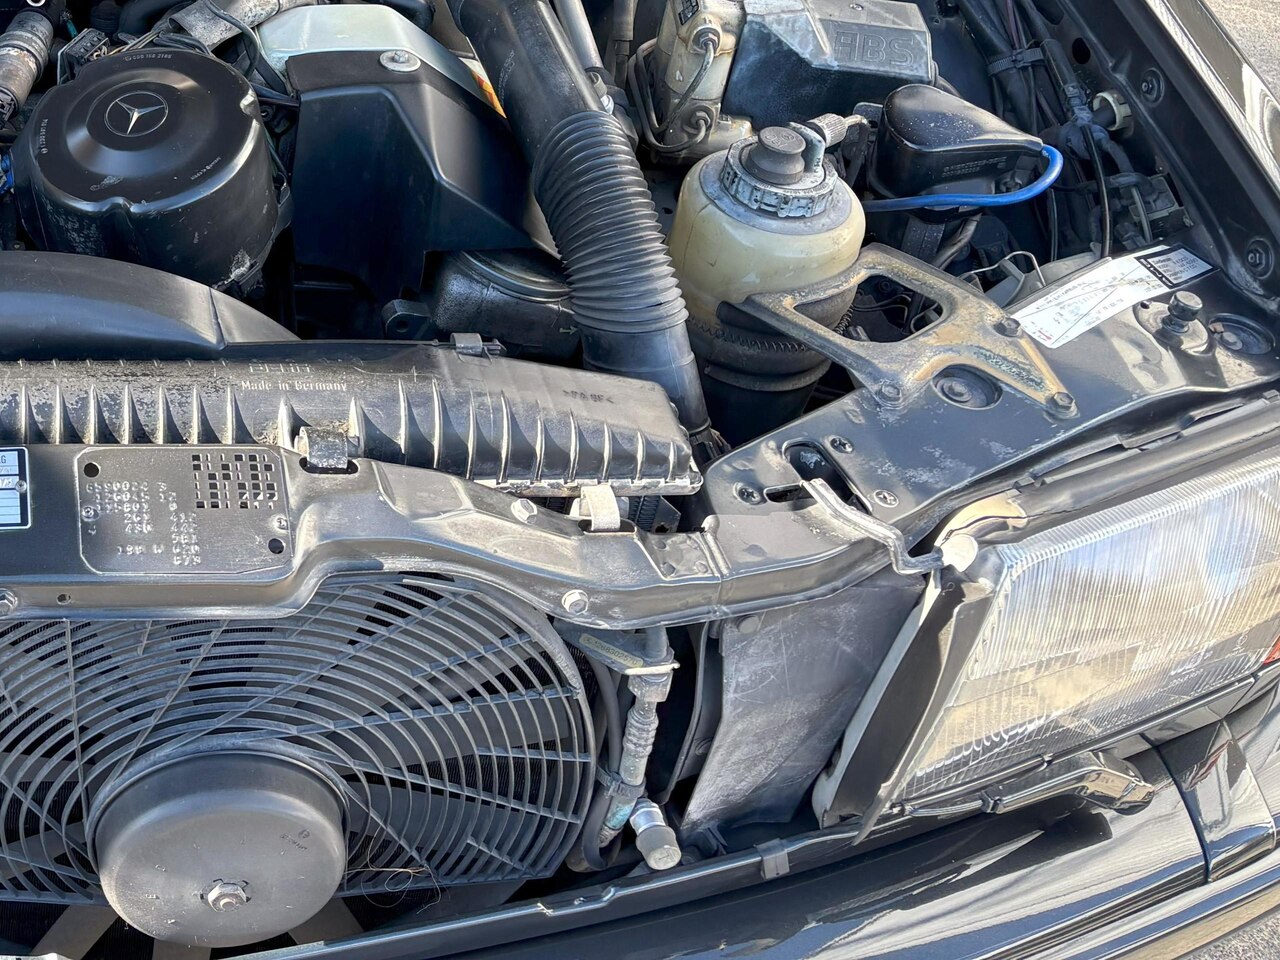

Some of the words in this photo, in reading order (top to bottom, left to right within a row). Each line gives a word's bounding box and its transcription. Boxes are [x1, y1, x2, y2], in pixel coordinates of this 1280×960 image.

[834, 31, 914, 66] ABS
[240, 380, 272, 391] Made
[278, 380, 290, 391] in
[294, 380, 348, 392] Germany
